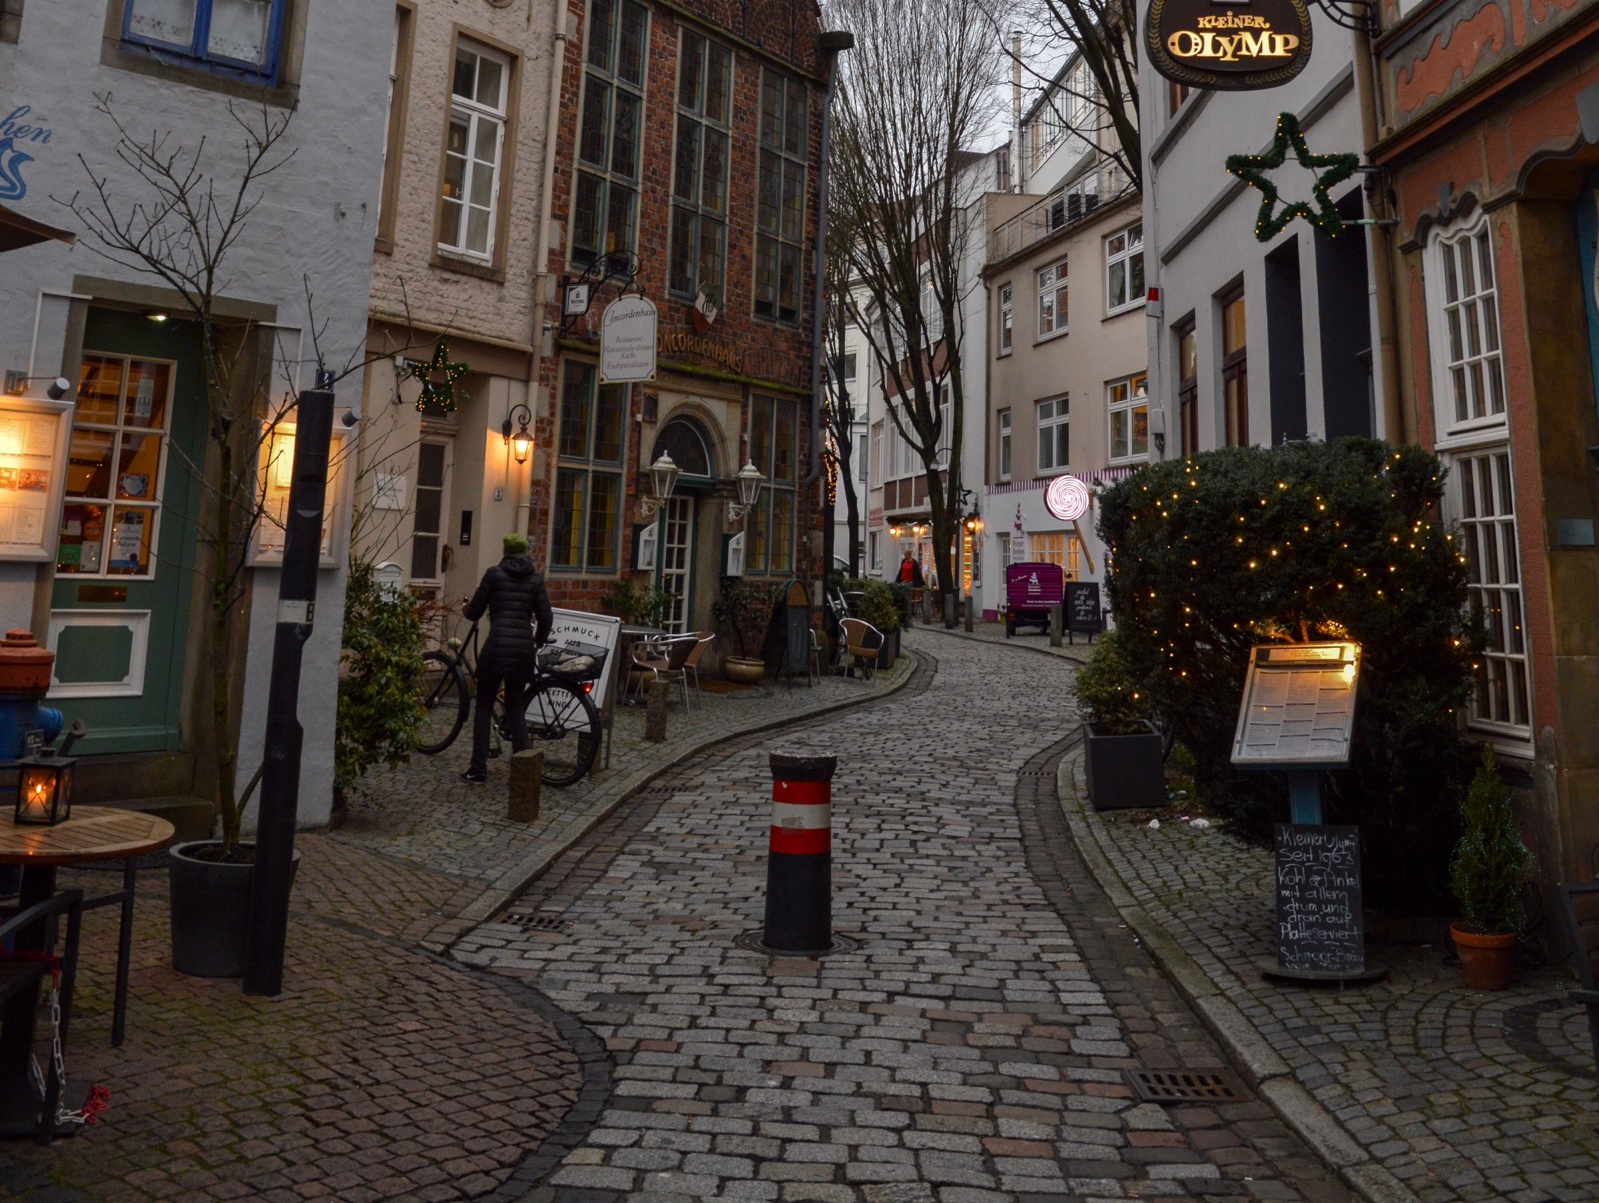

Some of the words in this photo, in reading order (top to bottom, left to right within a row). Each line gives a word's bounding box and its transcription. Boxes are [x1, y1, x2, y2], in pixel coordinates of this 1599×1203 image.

[0, 105, 52, 144] hen
[657, 333, 742, 372] ONCORDENHAUS
[550, 626, 601, 642] SCHMUCK
[564, 639, 580, 648] AUS
[1279, 847, 1313, 862] Seit
[1318, 846, 1355, 872] 1963
[1278, 866, 1306, 885] Kohl
[1281, 885, 1300, 898] mit
[1305, 886, 1348, 901] allem
[1325, 912, 1352, 929] auf
